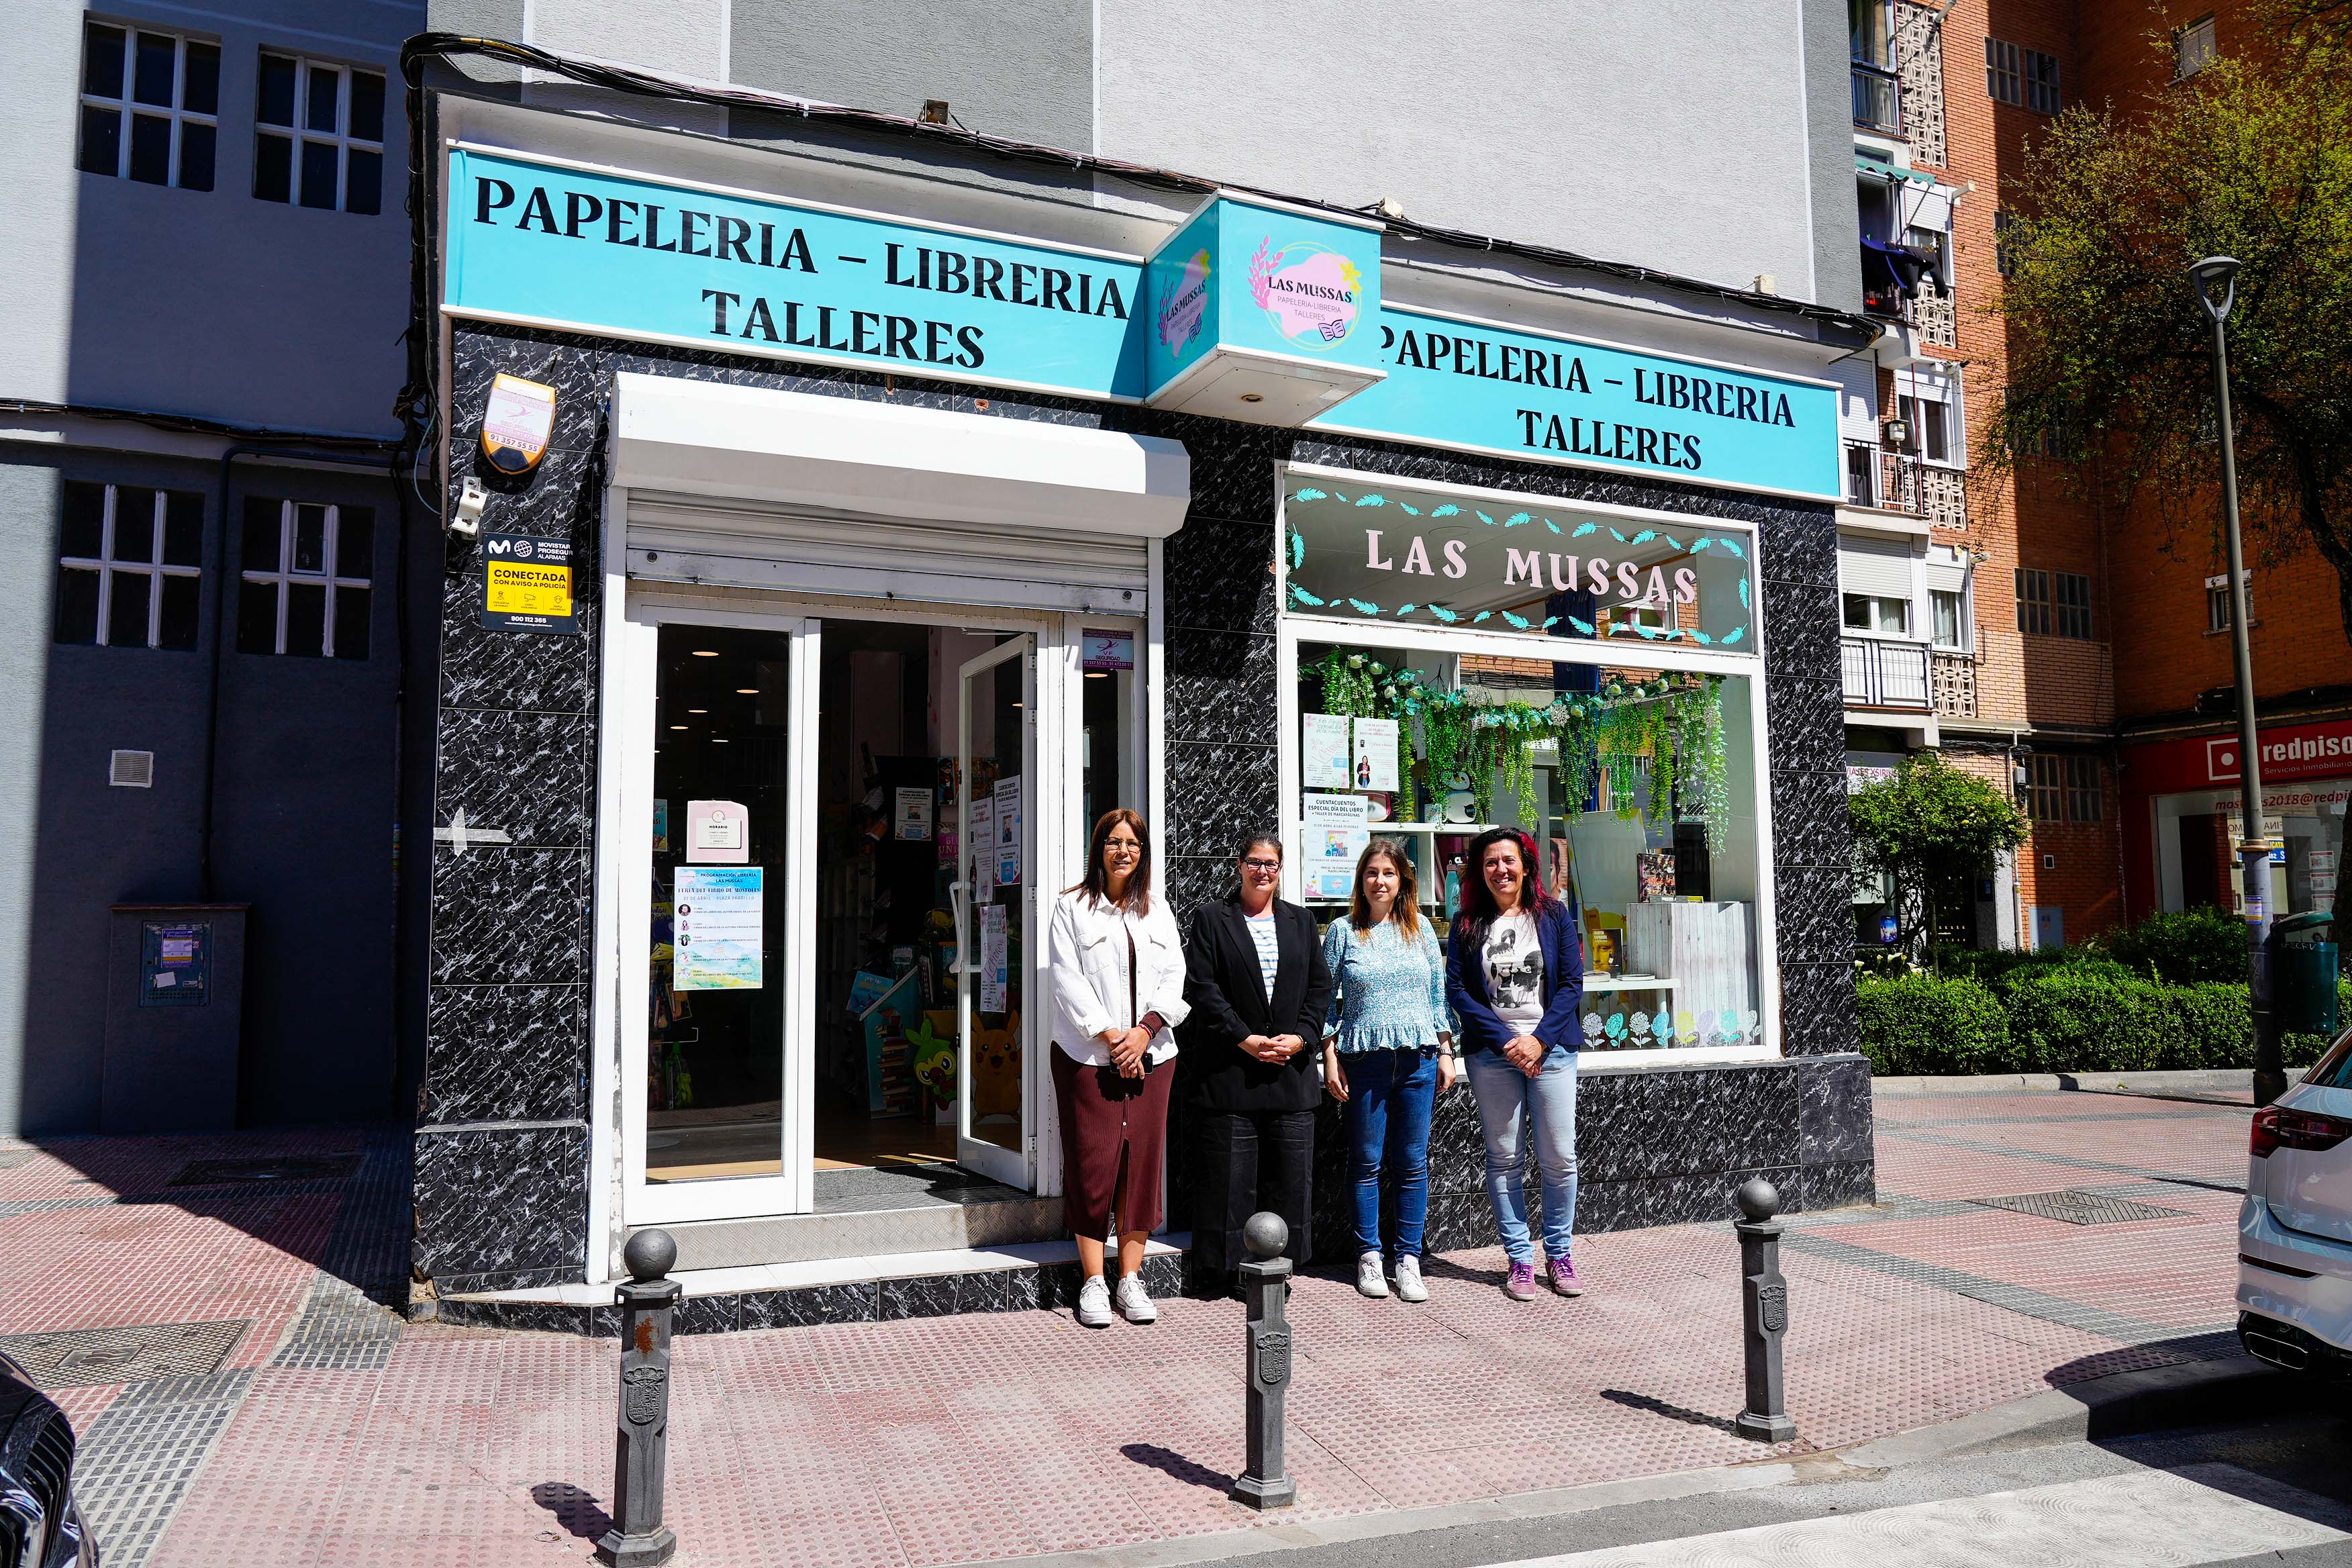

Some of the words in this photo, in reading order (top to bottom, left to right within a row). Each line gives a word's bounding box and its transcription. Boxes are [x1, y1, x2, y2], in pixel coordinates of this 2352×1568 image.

[474, 176, 819, 274] PAPELERIA
[885, 242, 1130, 321] LIBRERIA
[1166, 306, 1178, 322] LAS
[1179, 280, 1206, 312] MUSSAS
[1268, 277, 1293, 292] LAS
[1296, 282, 1353, 303] MUSSAS
[701, 289, 984, 369] TALLERES
[1294, 309, 1326, 321] TALLERES
[1634, 368, 1796, 428] LIBRERIA
[501, 436, 516, 446] 357
[517, 441, 527, 449] 55
[528, 444, 538, 452] 55
[1517, 409, 1703, 472] TALLERES
[494, 569, 566, 582] CONECTADA
[1365, 529, 1468, 581] LAS
[1504, 548, 1698, 605] MUSSAS
[2262, 734, 2352, 763] redpiso
[2264, 766, 2300, 775] Servicios
[2303, 761, 2352, 771] Inmobiliario
